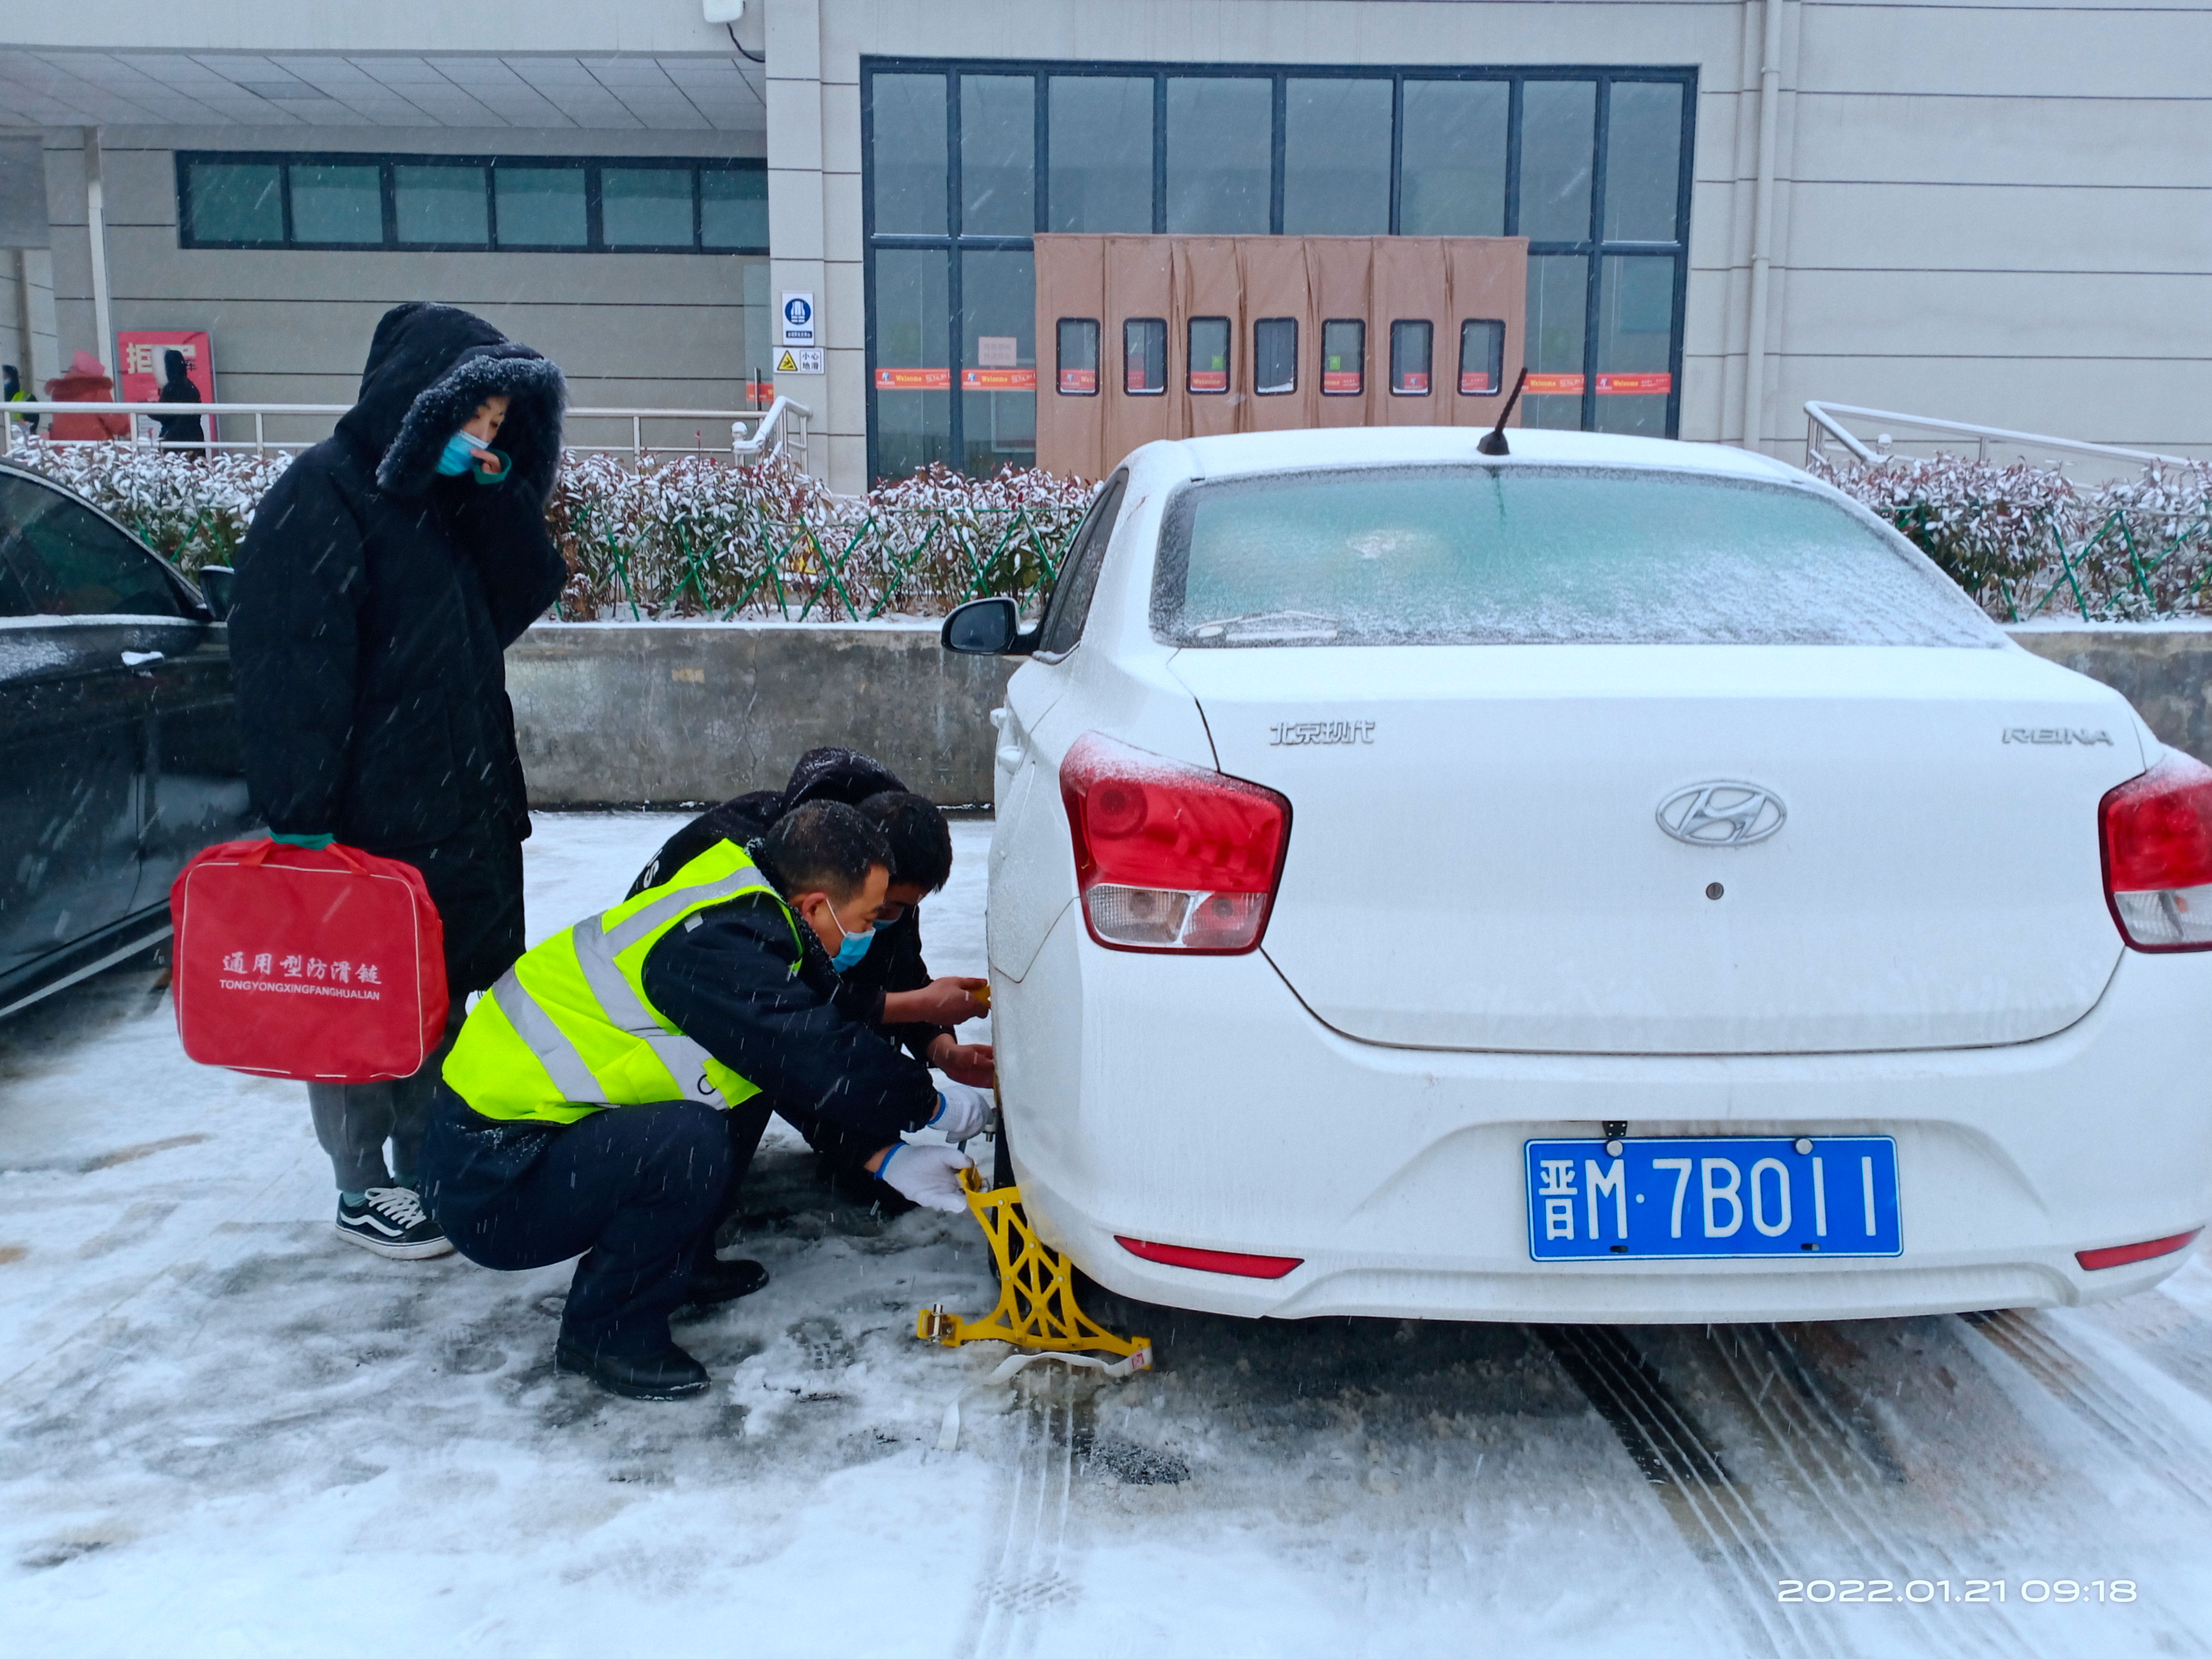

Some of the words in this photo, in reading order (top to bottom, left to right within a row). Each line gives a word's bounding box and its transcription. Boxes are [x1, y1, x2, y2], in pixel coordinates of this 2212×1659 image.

[1270, 720, 1376, 745] 北京现代
[2001, 727, 2114, 746] REINA
[219, 979, 380, 1000] TONGYONGXINGFANGHUALIAN
